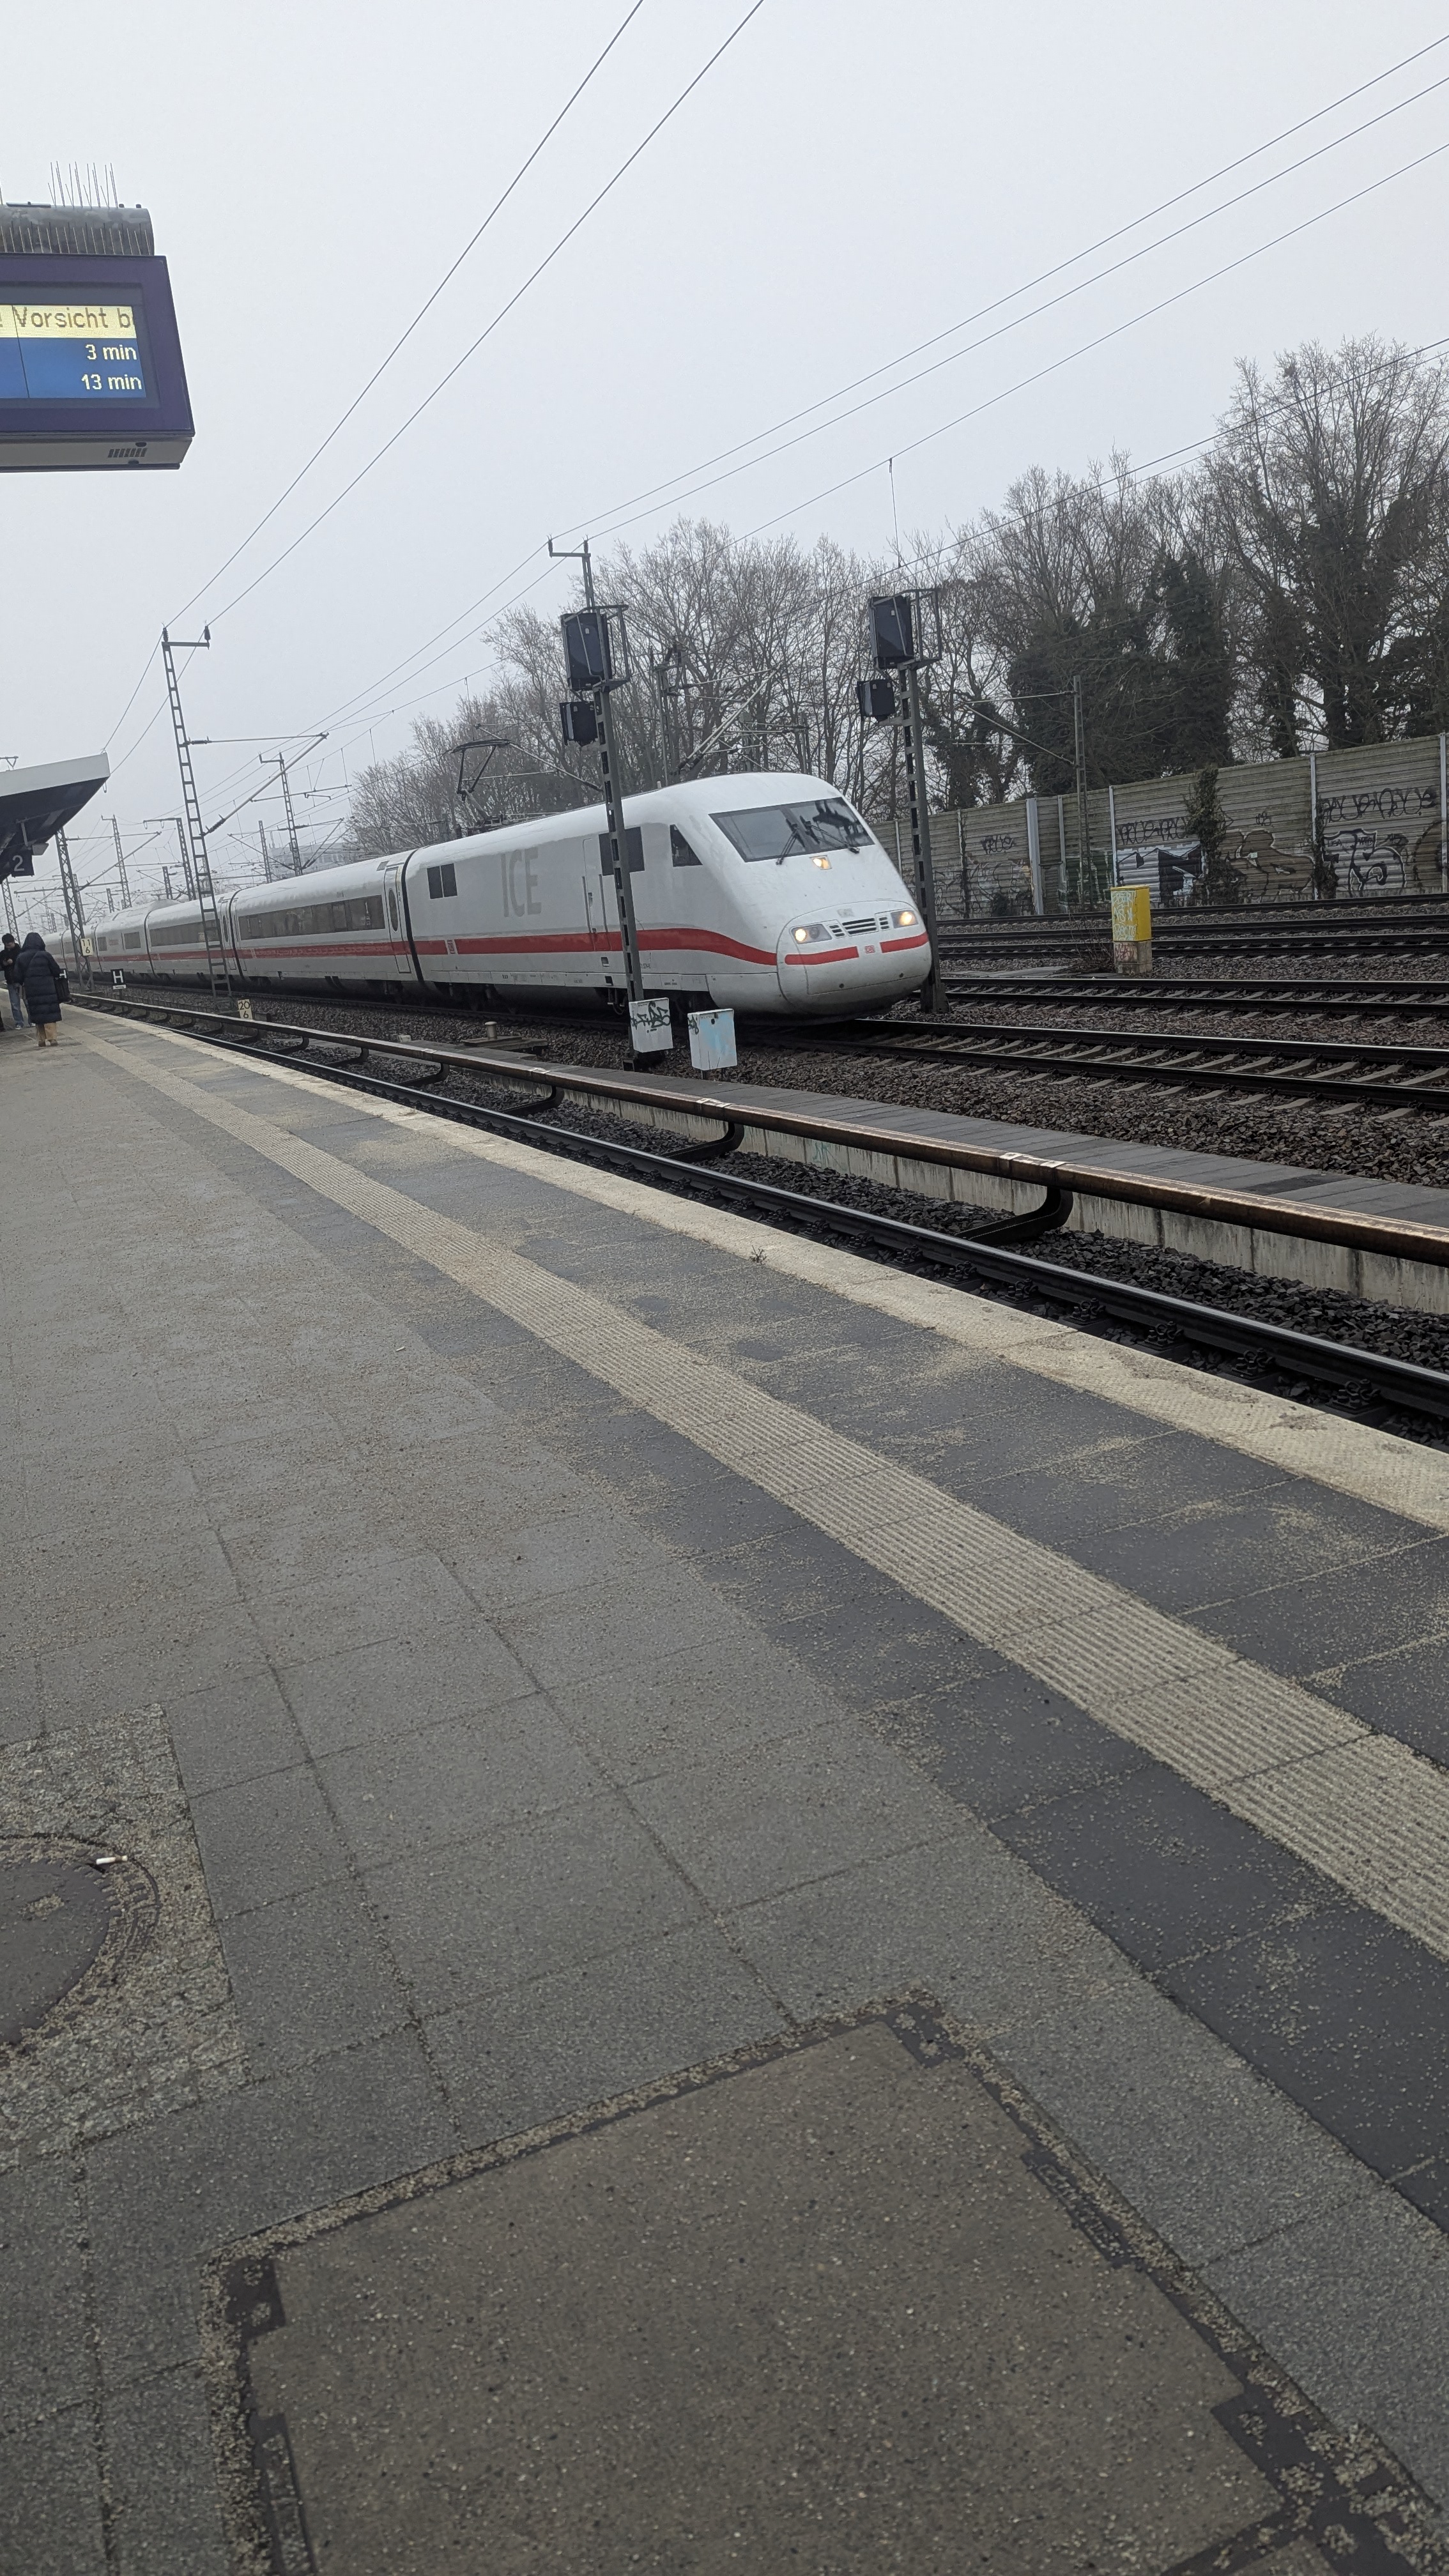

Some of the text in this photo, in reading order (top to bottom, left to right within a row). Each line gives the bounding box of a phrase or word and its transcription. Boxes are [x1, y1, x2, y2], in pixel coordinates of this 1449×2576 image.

[13, 307, 109, 328] Vorsicht
[85, 344, 137, 360] 3 min
[81, 374, 142, 390] 13 min
[12, 855, 25, 871] 2
[500, 847, 542, 917] ICE
[112, 970, 124, 983] H
[238, 1000, 250, 1010] 20
[243, 1011, 249, 1019] 6
